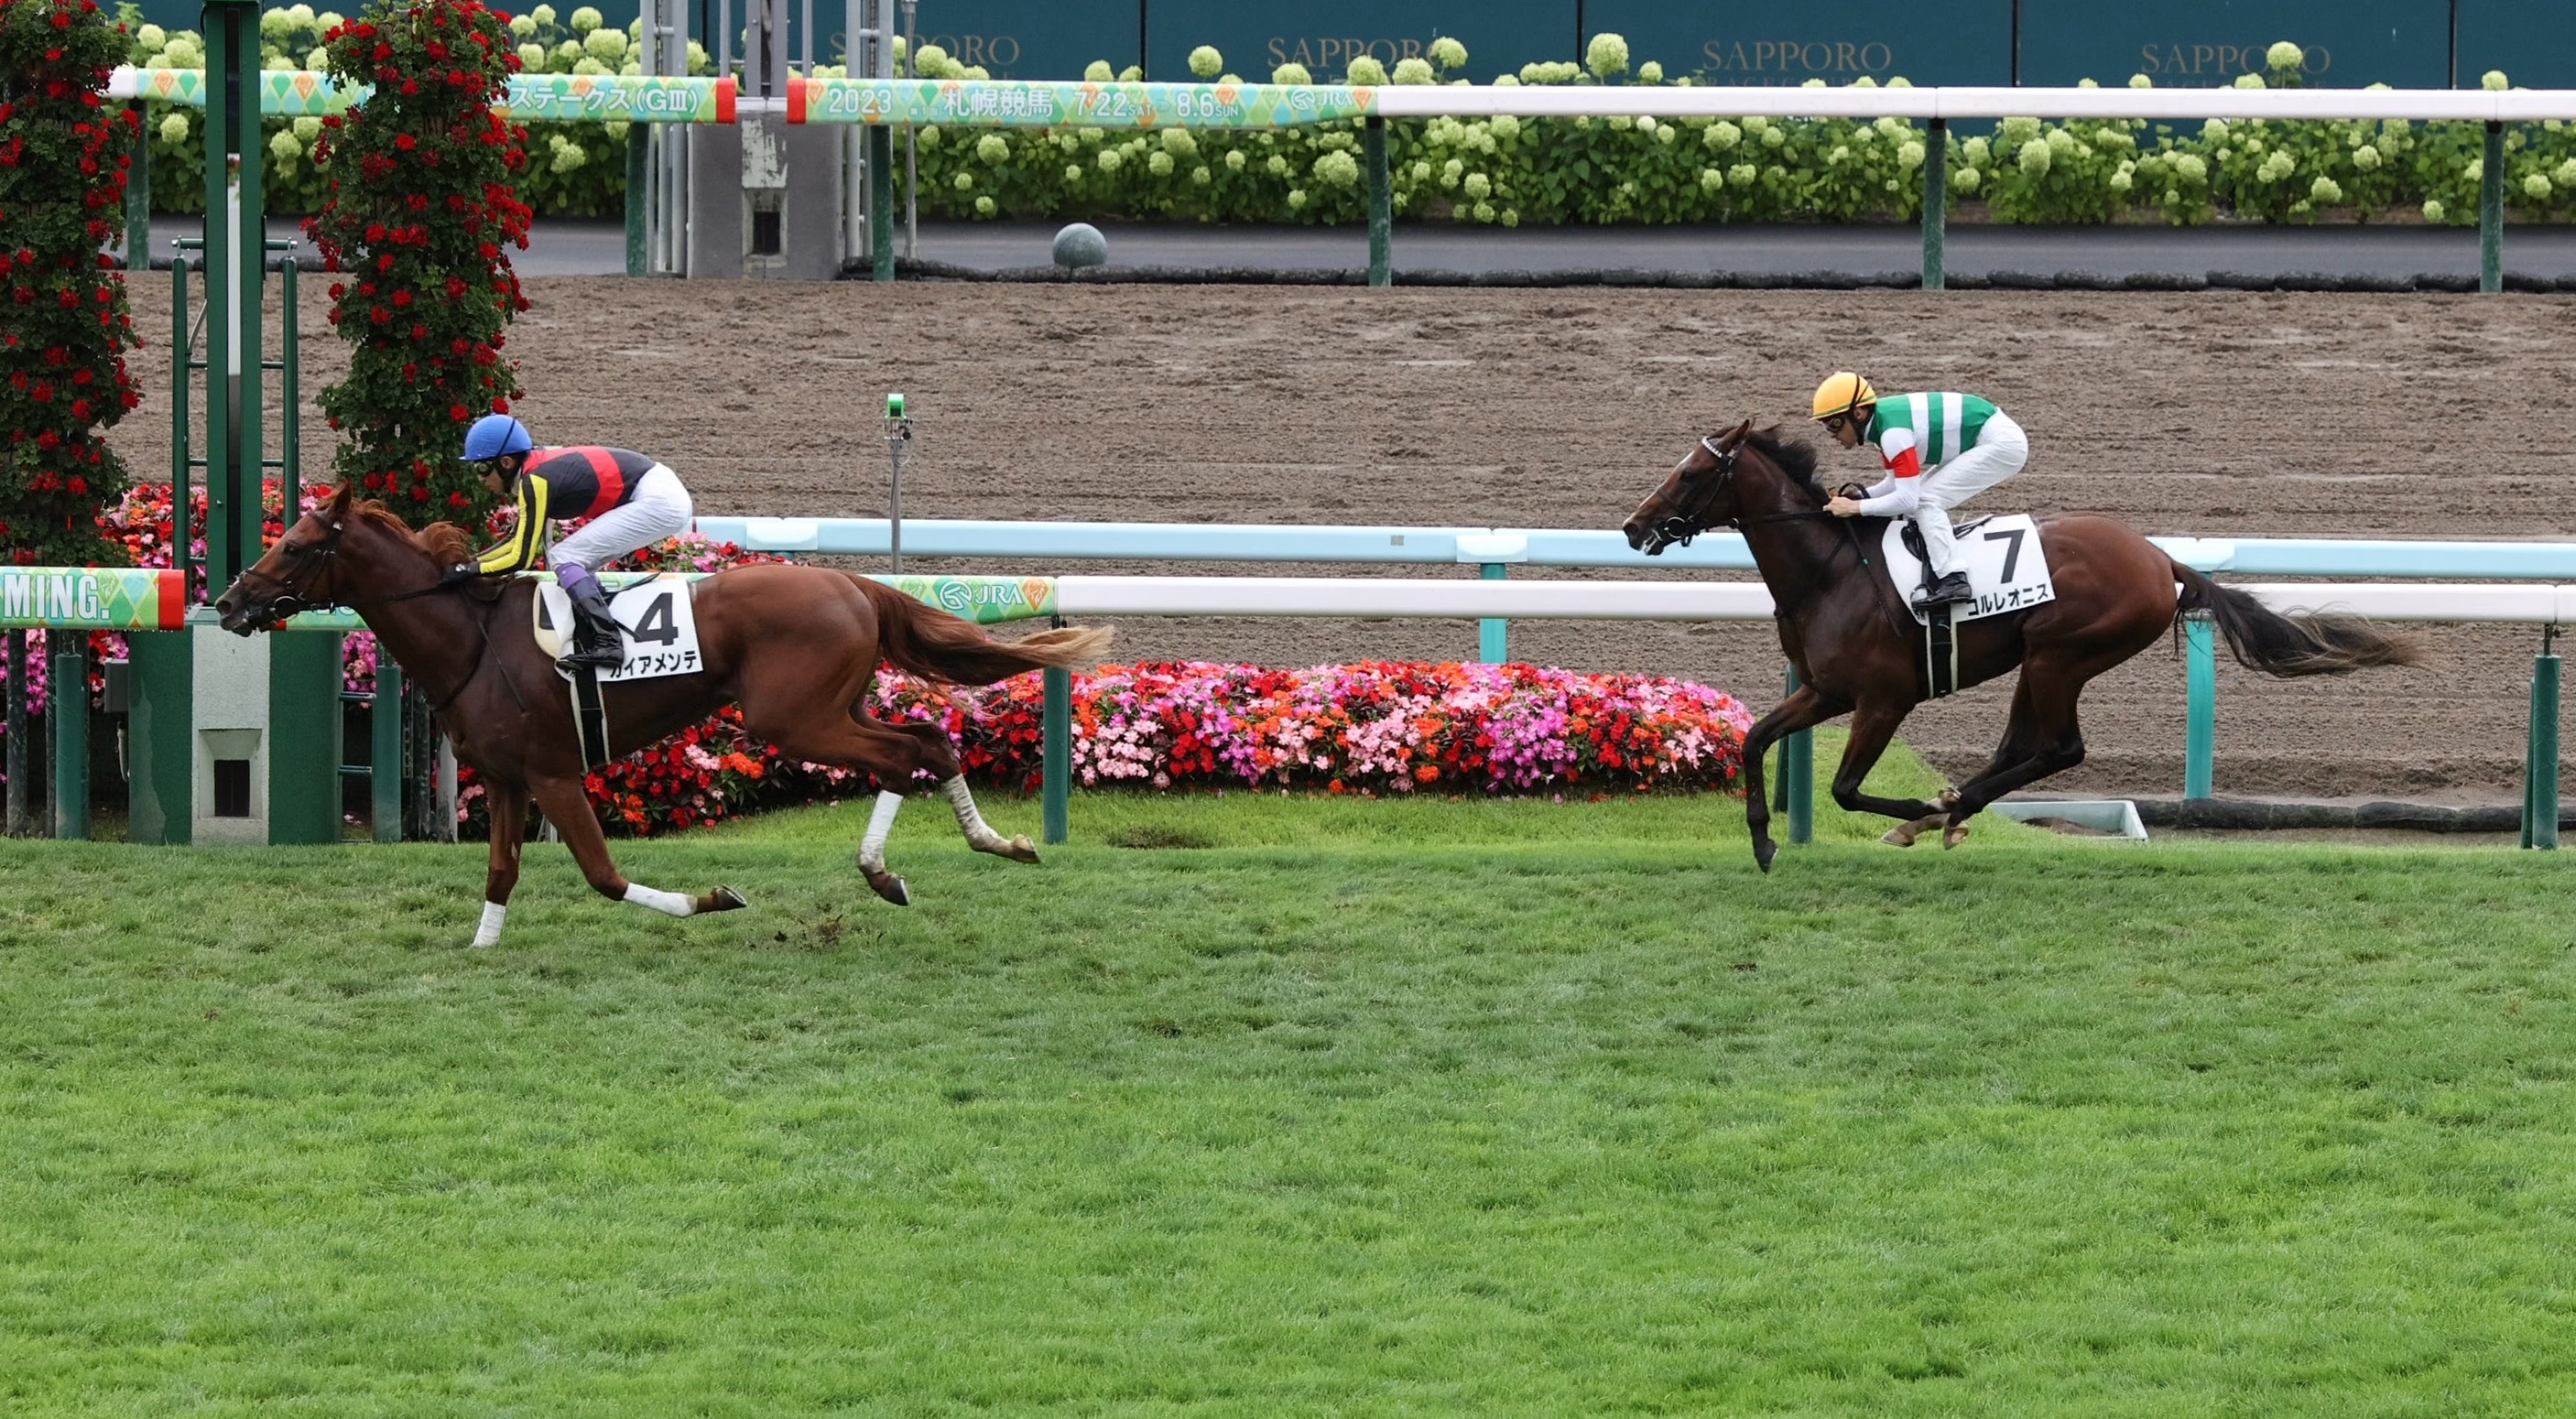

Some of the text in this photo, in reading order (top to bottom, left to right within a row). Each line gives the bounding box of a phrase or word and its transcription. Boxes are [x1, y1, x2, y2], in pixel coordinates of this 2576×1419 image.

[1702, 40, 1893, 71] SAPPORO
[2141, 44, 2331, 74] SAPPOO
[828, 88, 892, 114] 2023
[943, 88, 1053, 118] 札幌競馬
[1319, 92, 1353, 107] JRA
[1983, 528, 2027, 585] 7
[3, 573, 111, 620] MING.
[975, 583, 1025, 605] JRA
[1967, 583, 2049, 616] コルレオニス
[633, 591, 679, 646] 4
